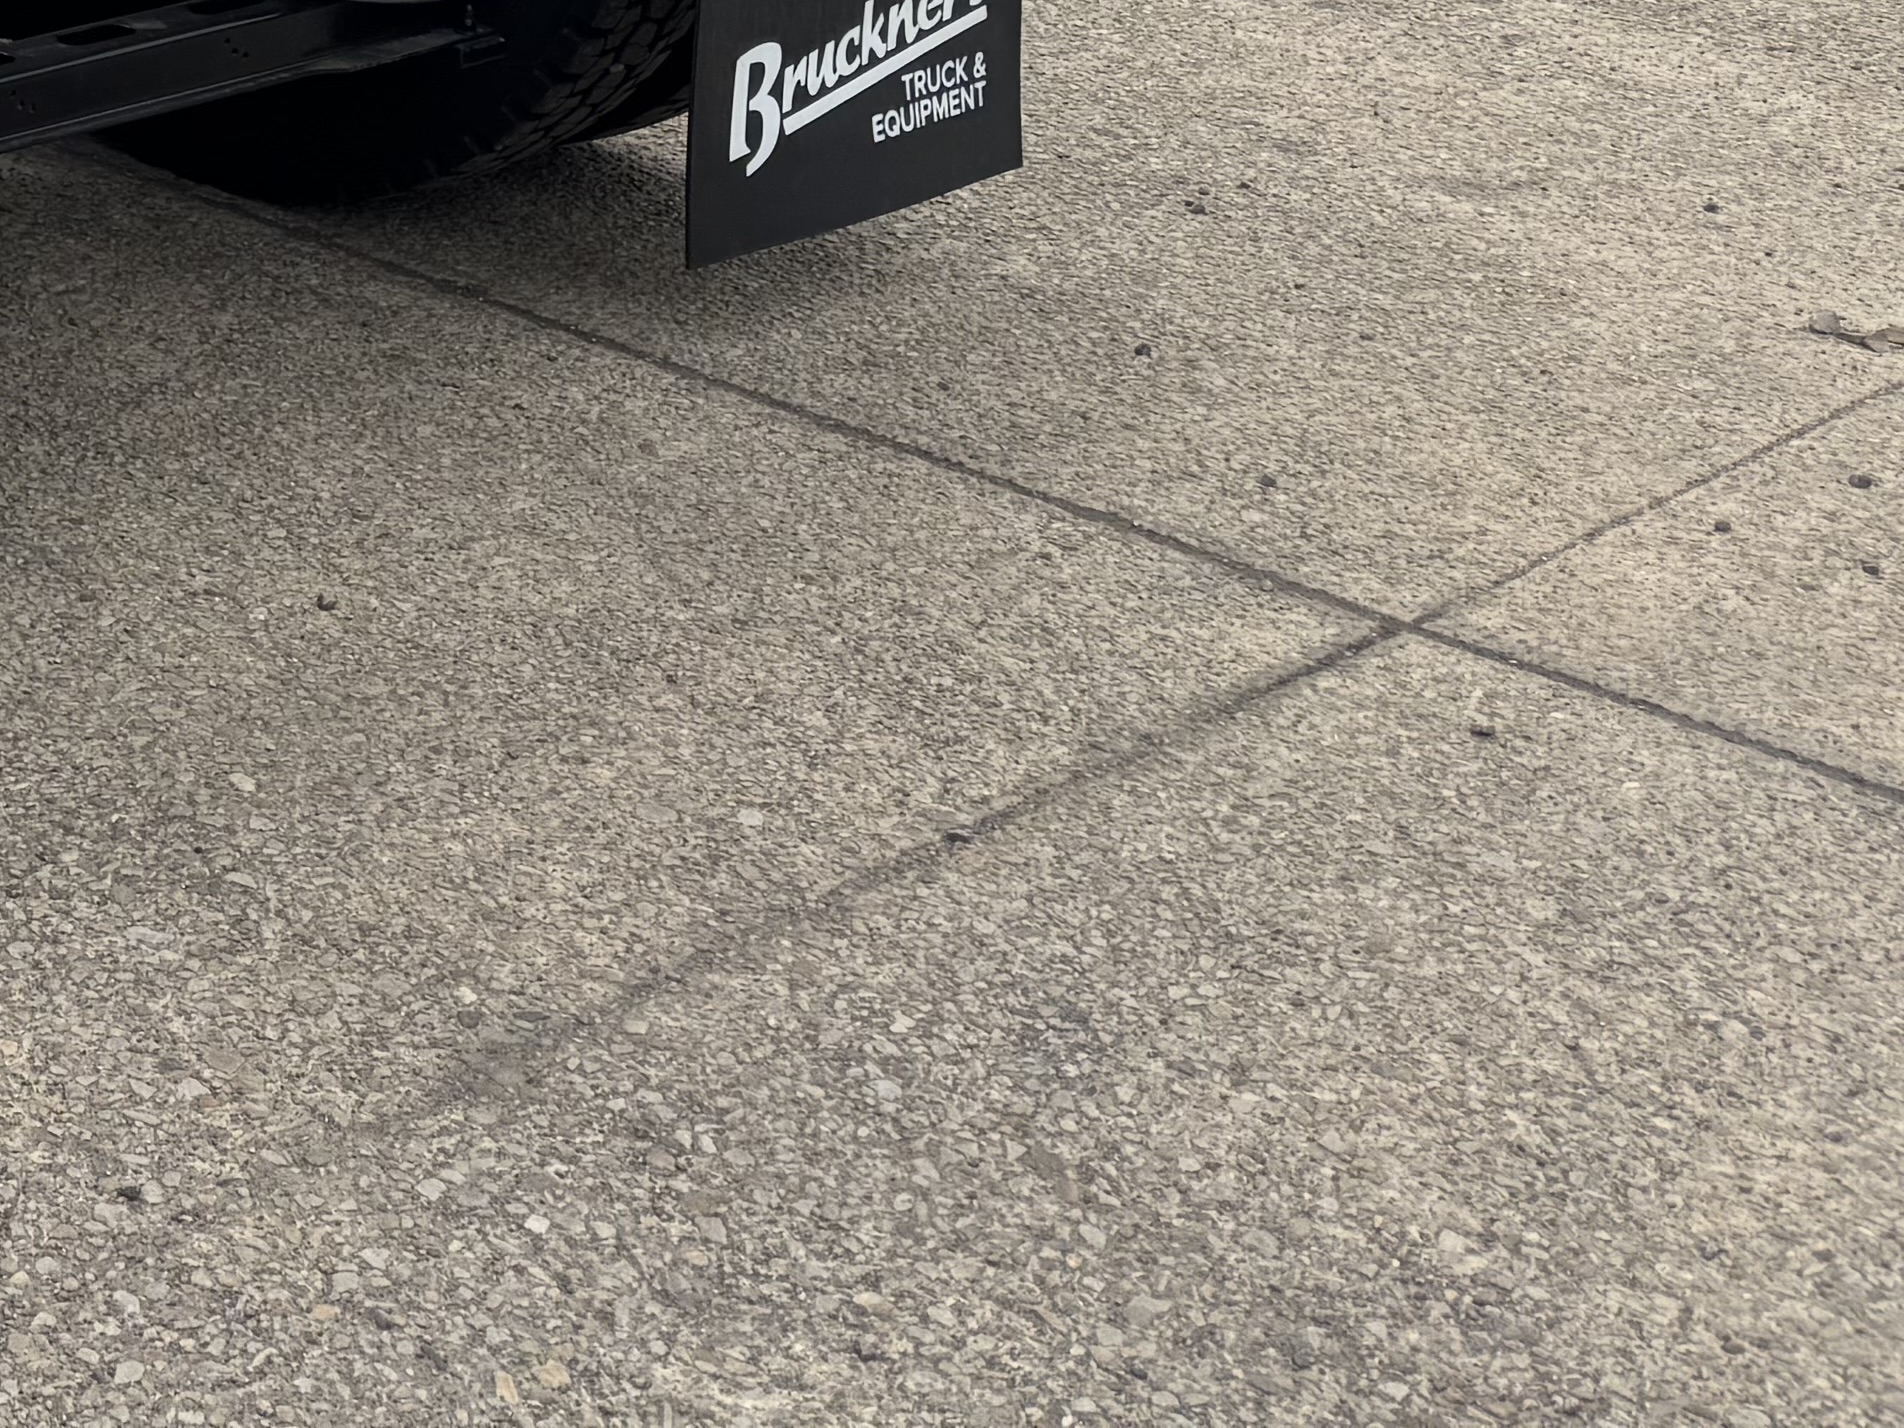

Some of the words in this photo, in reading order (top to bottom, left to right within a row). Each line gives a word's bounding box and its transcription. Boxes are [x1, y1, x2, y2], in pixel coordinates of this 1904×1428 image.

[901, 57, 968, 102] TRUCK
[972, 51, 987, 79] &
[871, 81, 987, 144] EQUIPMENT
